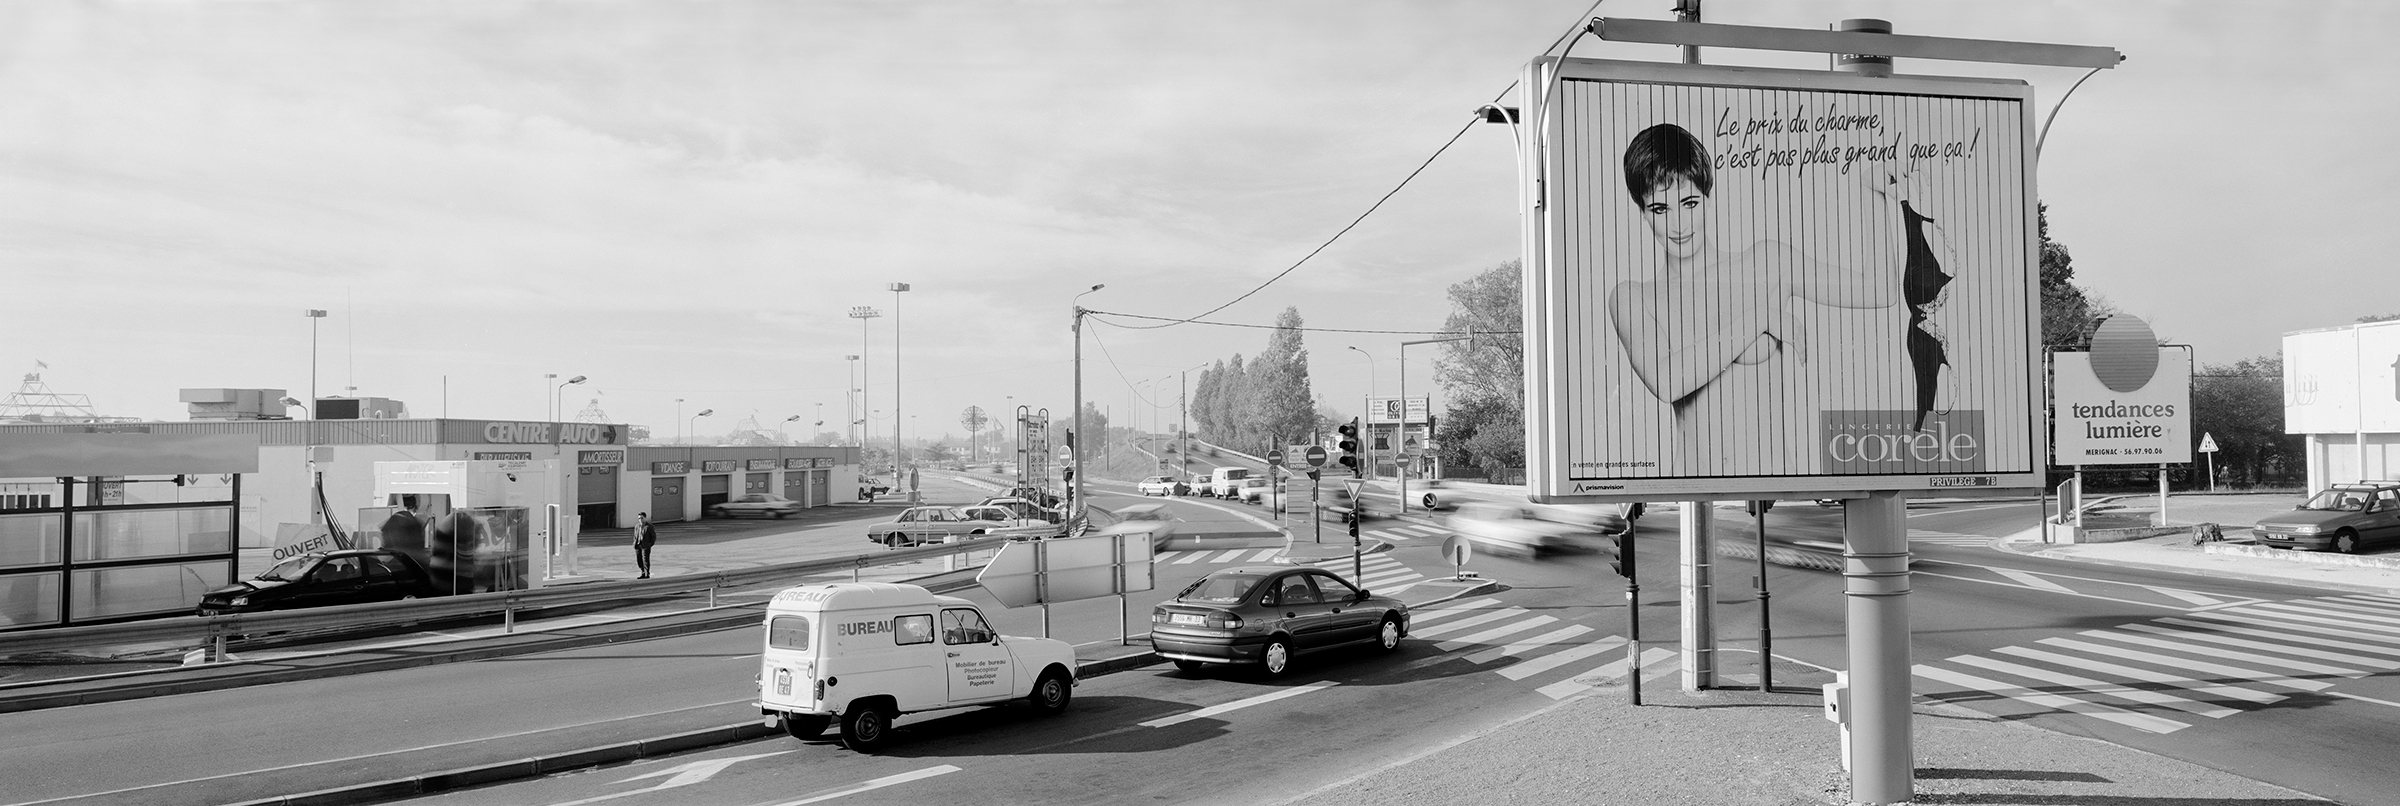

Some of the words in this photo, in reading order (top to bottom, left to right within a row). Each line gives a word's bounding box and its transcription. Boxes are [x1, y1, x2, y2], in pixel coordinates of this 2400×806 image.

[1716, 107, 1740, 138] Le
[1742, 111, 1783, 148] prix
[1789, 104, 1809, 133] du
[1814, 103, 1885, 137] charme,
[1714, 143, 1761, 170] c'est
[1762, 149, 1798, 181] pas
[1798, 134, 1839, 178] plus
[1842, 131, 1902, 175] grand
[1909, 140, 1939, 173] que
[2072, 399, 2175, 418] tendances
[484, 421, 550, 444] CENTRE
[559, 423, 600, 444] AUTO
[1829, 423, 1912, 431] LINGERIE
[2085, 420, 2162, 439] lumière
[582, 451, 622, 464] AMORTISSEUR
[2085, 448, 2118, 456] MERIGNAC
[2124, 448, 2163, 456] 56.97.90.06
[660, 462, 684, 473] VIDANGE
[1605, 461, 1629, 469] grandes
[1630, 460, 1656, 468] surfaces
[1931, 477, 1977, 486] PRIVILEGE
[273, 533, 329, 561] OUVERT
[837, 619, 894, 637] BUREAU
[967, 673, 997, 681] Bureautique
